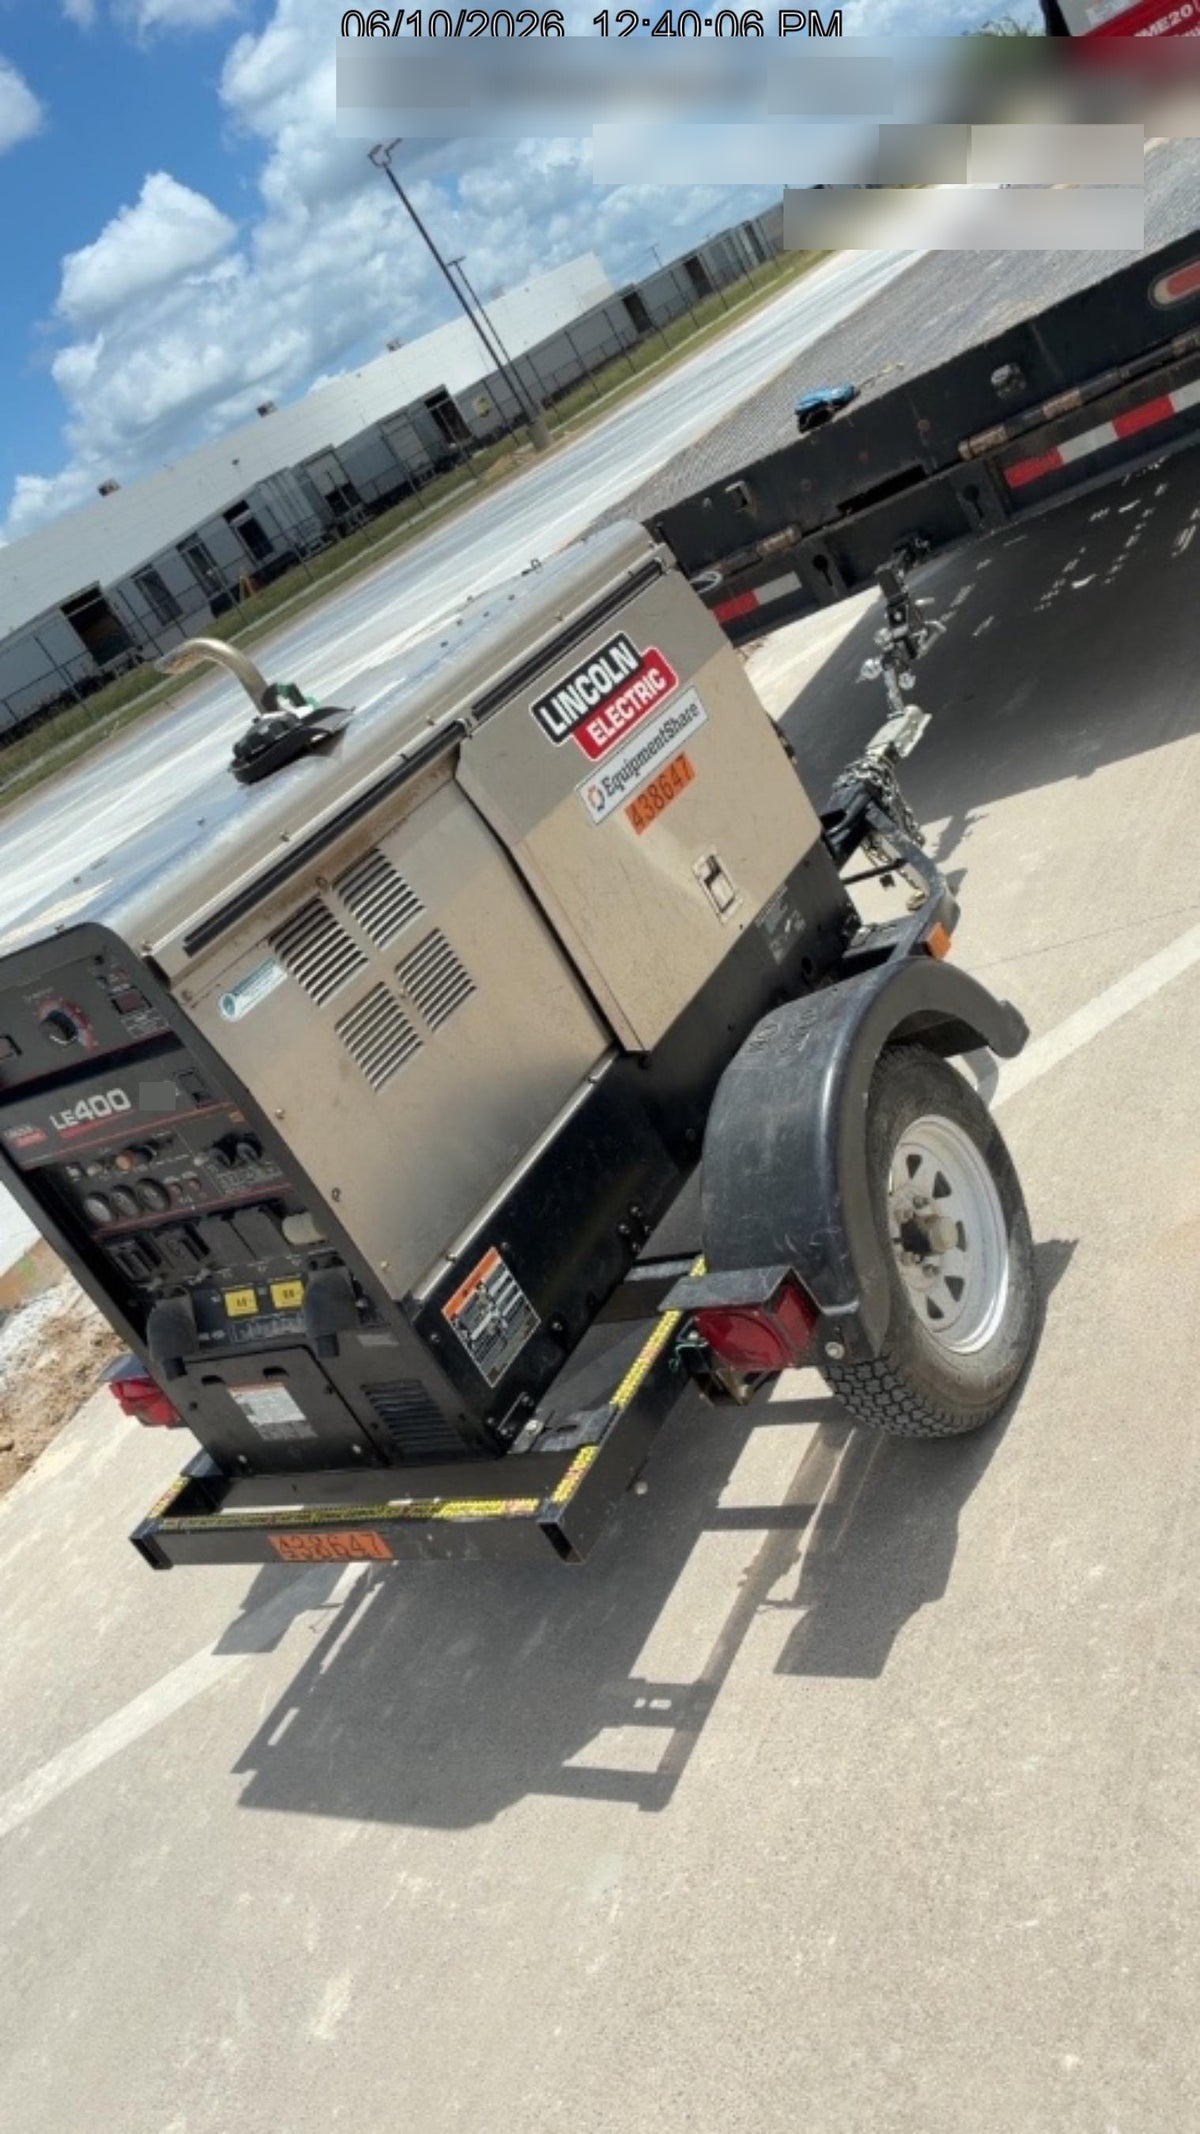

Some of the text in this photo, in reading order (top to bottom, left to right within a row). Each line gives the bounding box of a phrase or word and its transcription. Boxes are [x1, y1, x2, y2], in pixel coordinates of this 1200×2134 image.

[539, 640, 640, 736] LINCOLN
[585, 667, 668, 747] ELECTRIC
[601, 702, 700, 798] EquipmentShare
[629, 752, 692, 830] 438647
[49, 1087, 132, 1131] LE400
